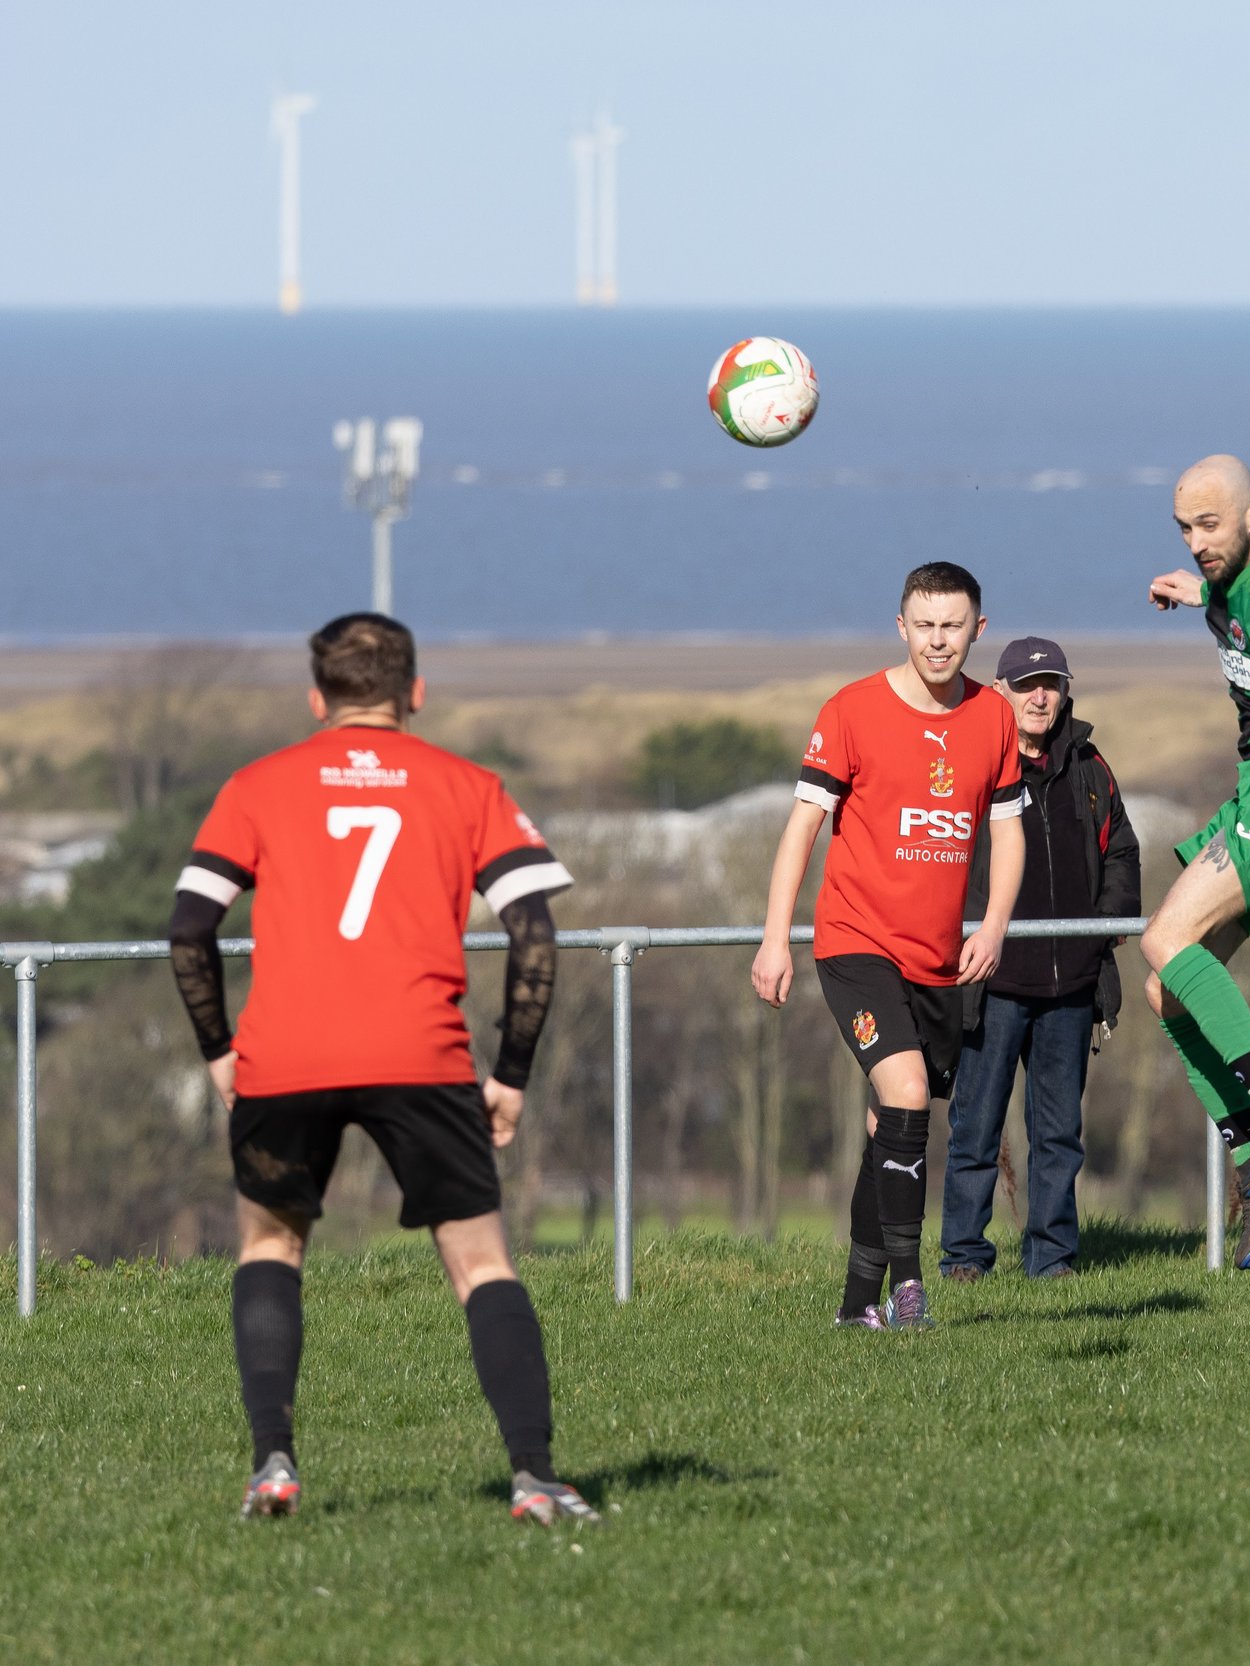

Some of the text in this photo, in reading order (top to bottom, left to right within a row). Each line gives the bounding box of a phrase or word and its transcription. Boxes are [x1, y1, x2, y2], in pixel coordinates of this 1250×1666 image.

[899, 807, 972, 840] PSS
[895, 847, 931, 862] AUTO
[327, 806, 402, 940] 7
